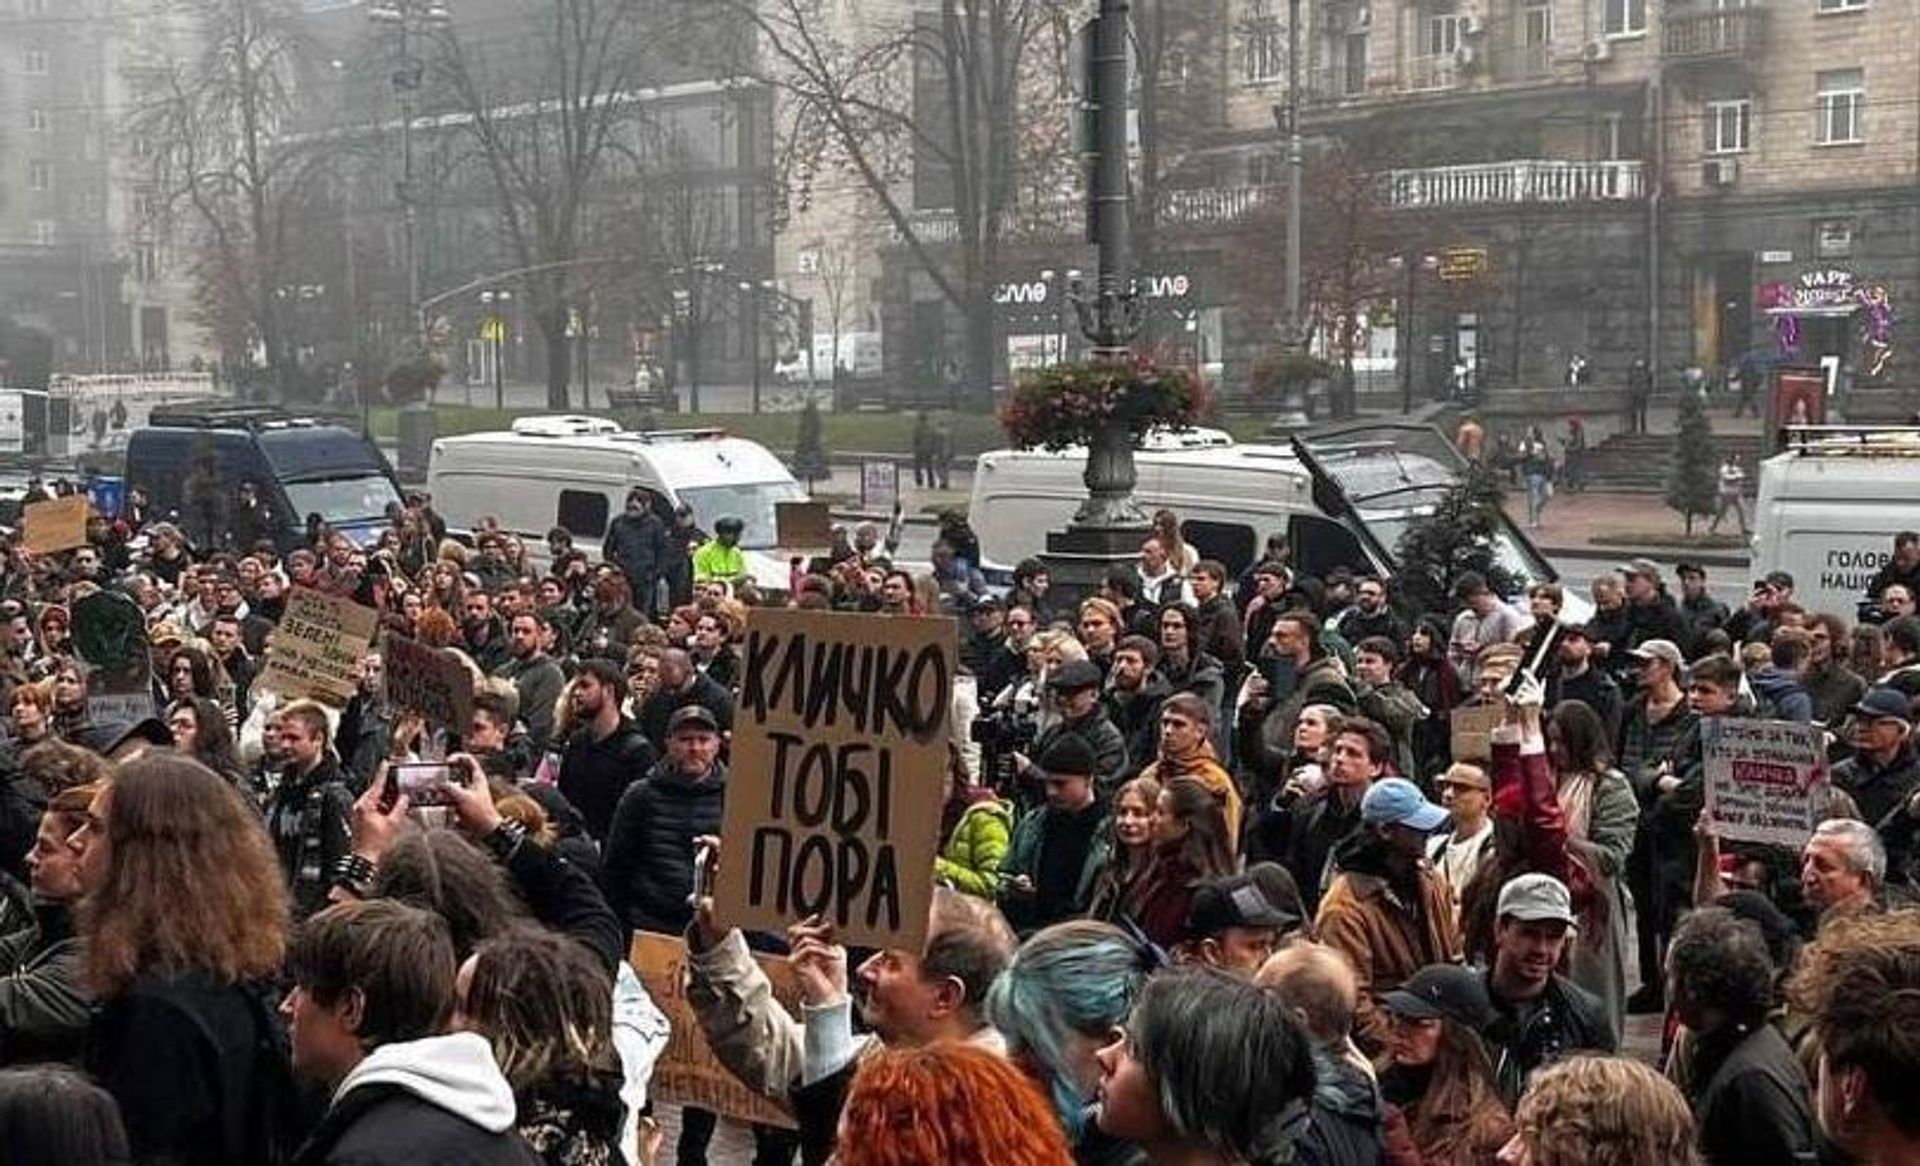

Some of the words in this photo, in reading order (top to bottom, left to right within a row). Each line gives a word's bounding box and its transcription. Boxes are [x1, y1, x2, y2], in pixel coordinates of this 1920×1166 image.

[1801, 270, 1851, 287] VAPE
[1827, 550, 1894, 569] ГОЛОВ
[741, 631, 948, 744] КЛИЧКО
[767, 732, 892, 841] ТОБІ
[749, 826, 900, 930] ПОРА
